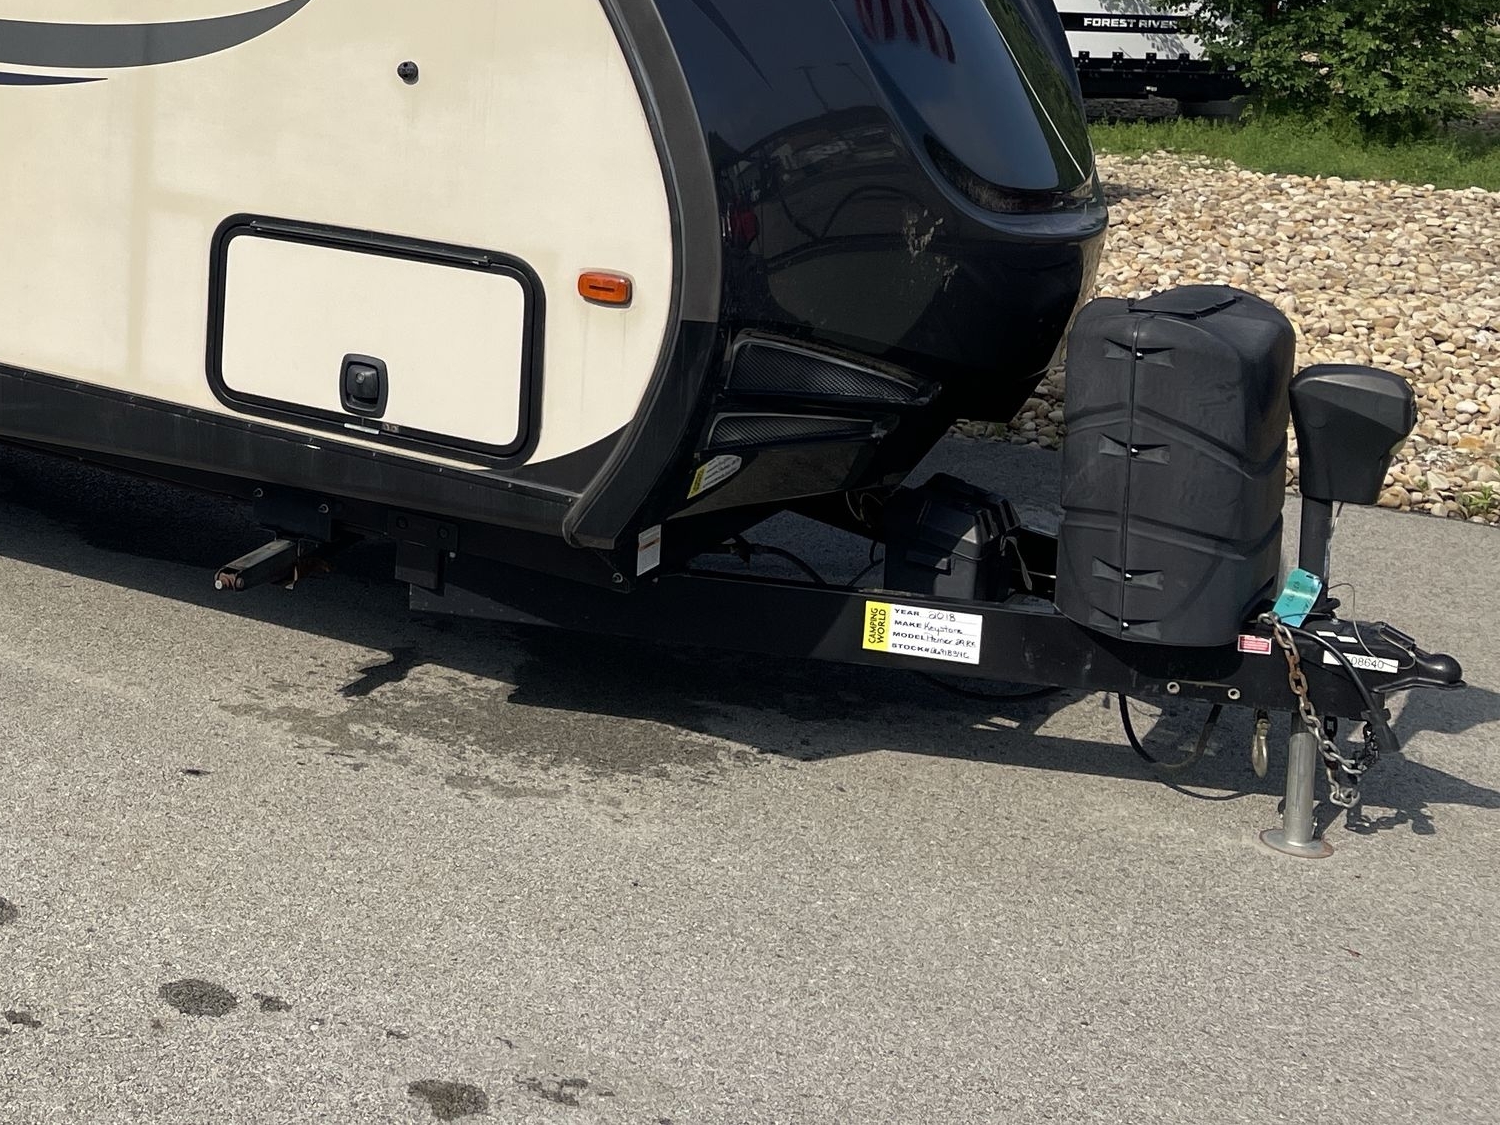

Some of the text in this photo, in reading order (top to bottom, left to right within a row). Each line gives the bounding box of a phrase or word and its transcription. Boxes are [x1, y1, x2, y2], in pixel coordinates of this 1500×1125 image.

[1083, 17, 1179, 29] FOREST RIVER
[894, 608, 956, 622] YEAR 2018
[868, 607, 879, 644] CAMPING
[876, 608, 887, 644] WORLD
[894, 619, 922, 629] MAKE
[892, 631, 925, 641] MODEL
[891, 642, 930, 653] STOCK#
[1345, 655, 1385, 670] 08640
